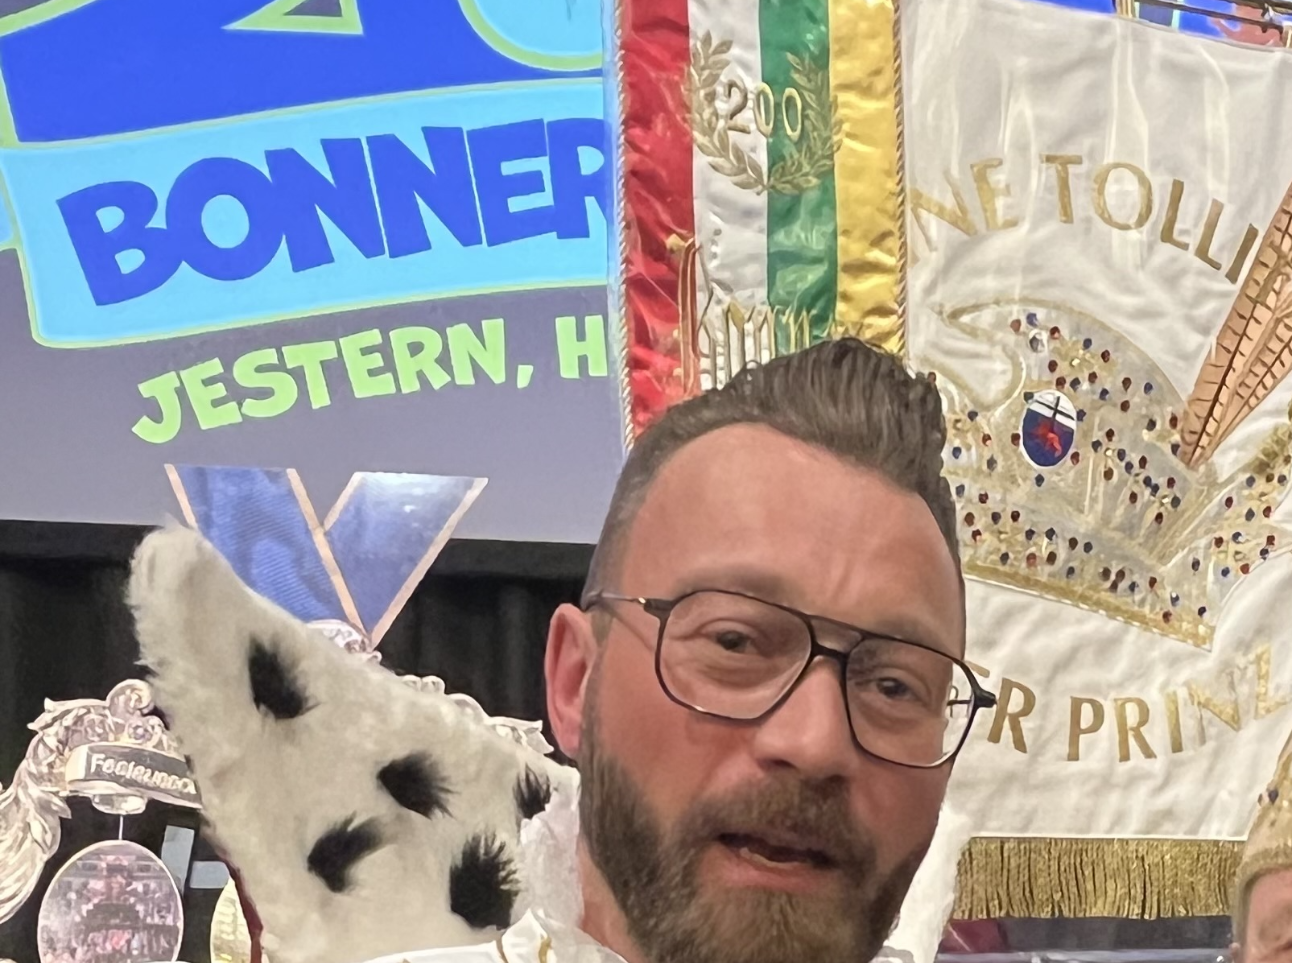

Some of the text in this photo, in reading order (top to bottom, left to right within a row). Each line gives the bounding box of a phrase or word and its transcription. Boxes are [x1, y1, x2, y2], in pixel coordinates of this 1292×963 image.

[714, 79, 801, 142] 200
[57, 117, 612, 305] BONNER
[907, 158, 1019, 268] NE
[131, 318, 531, 443] JESTERN,
